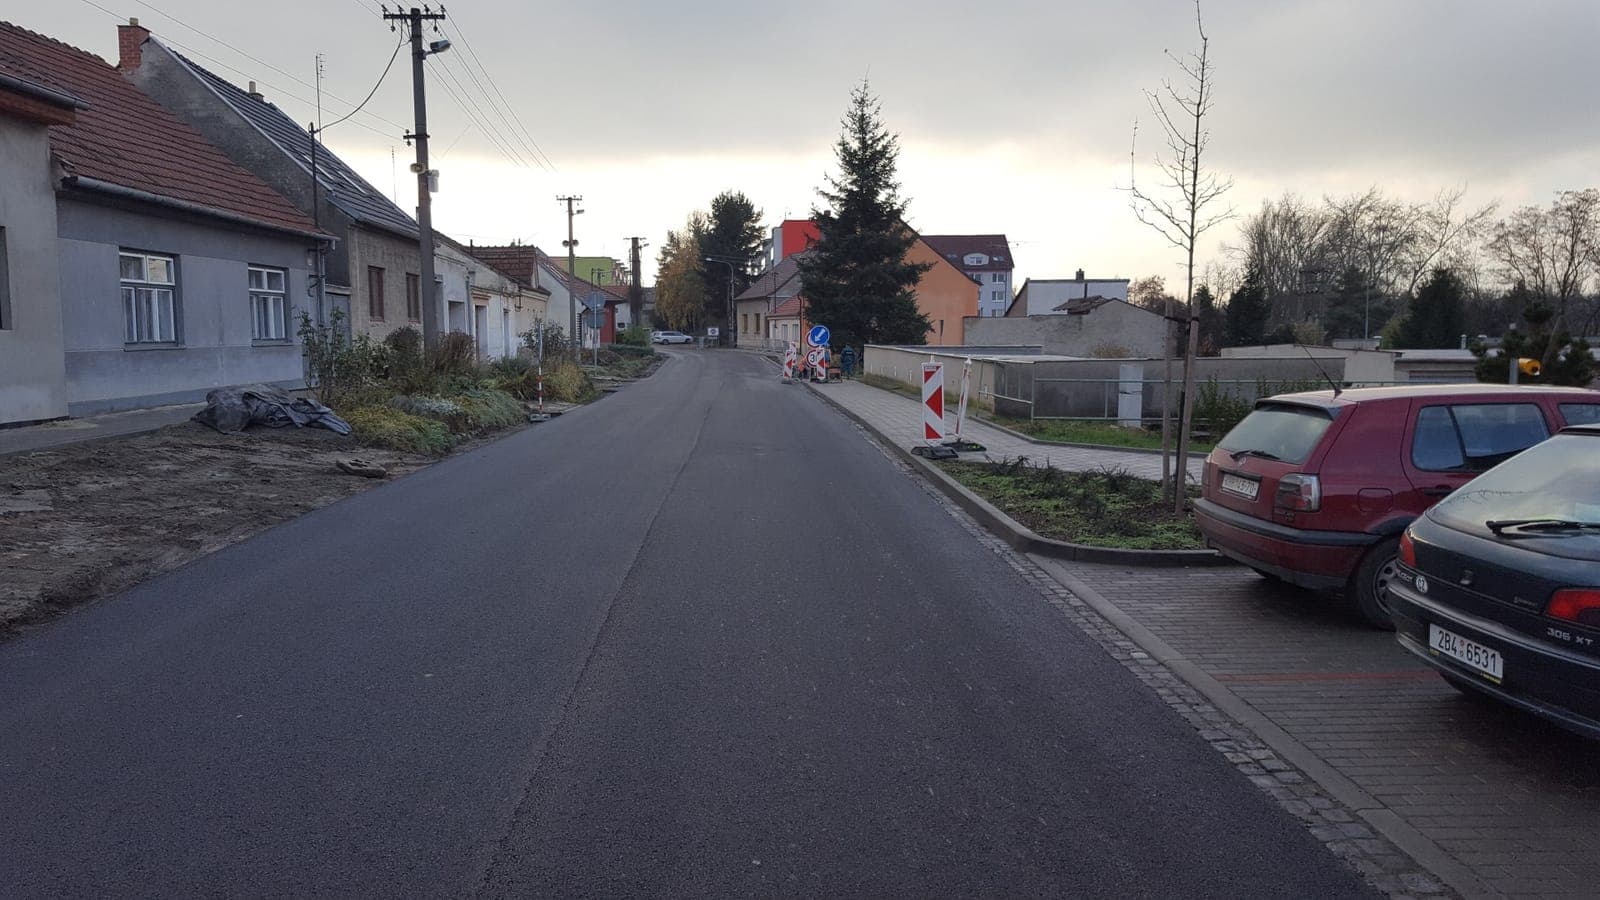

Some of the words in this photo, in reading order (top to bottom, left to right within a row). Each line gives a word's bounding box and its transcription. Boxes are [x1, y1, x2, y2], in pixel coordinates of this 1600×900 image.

[1546, 627, 1571, 641] 306
[1575, 636, 1593, 645] XT
[1438, 630, 1457, 655] 2B4
[1466, 642, 1496, 673] 6531
